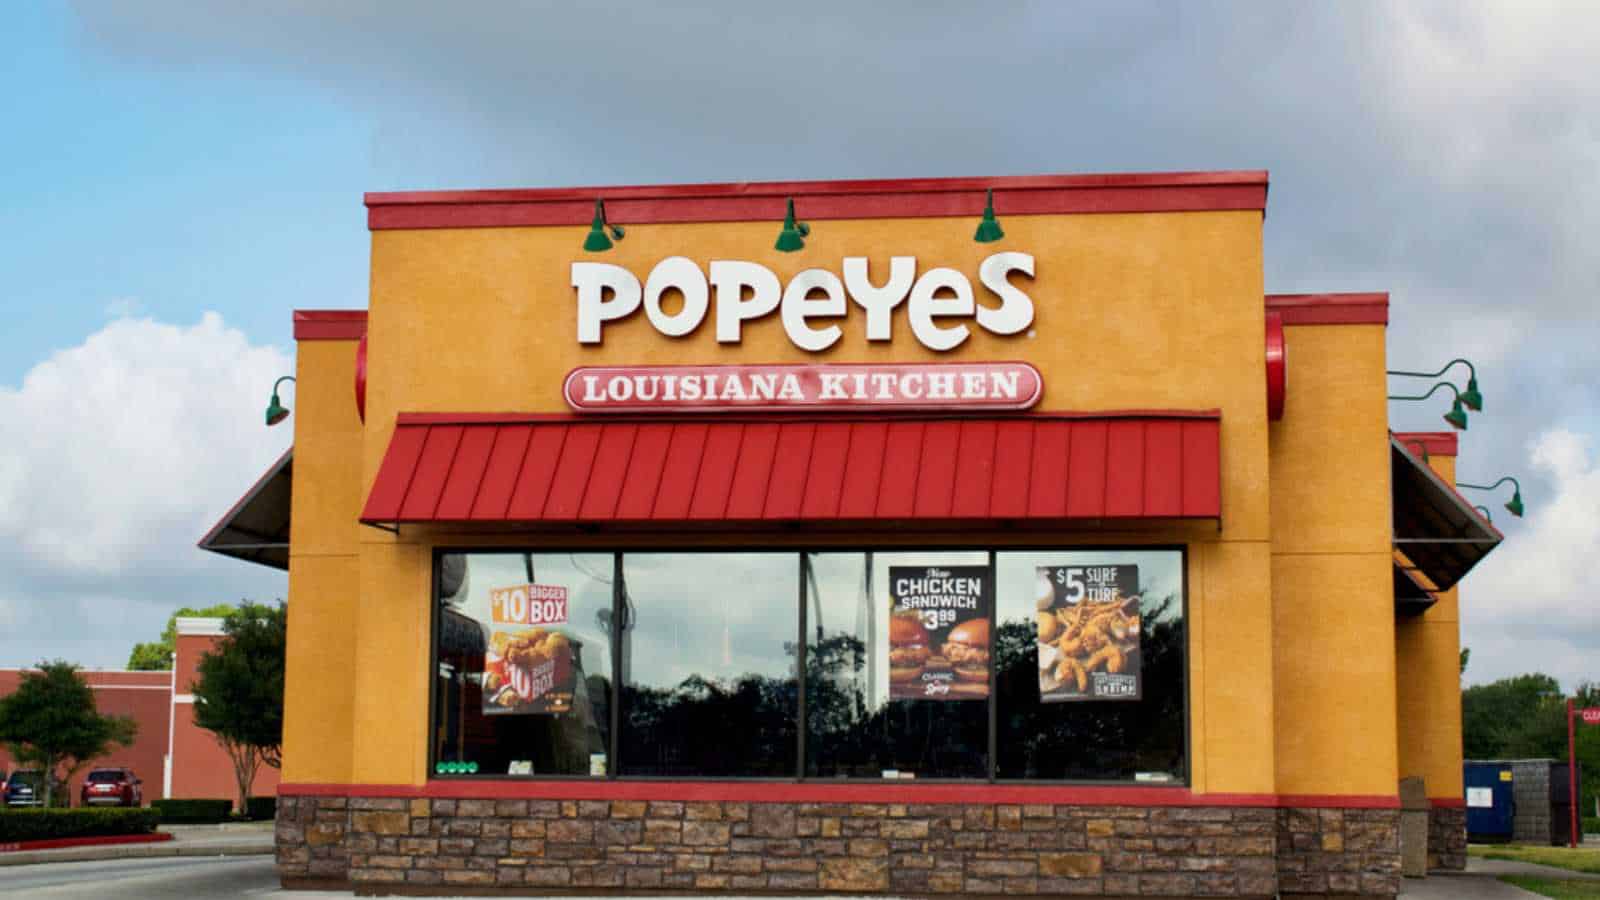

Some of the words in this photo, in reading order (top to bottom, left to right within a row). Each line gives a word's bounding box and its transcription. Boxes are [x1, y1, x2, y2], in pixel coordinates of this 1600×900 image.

[583, 374, 805, 402] LOUISIANA
[819, 371, 1021, 399] KITCHEN
[896, 578, 981, 597] CHICKEN
[1056, 568, 1085, 604] $5
[1086, 567, 1118, 583] SURF
[1087, 587, 1119, 602] TURF
[531, 600, 566, 623] BOX
[901, 595, 977, 609] SANDWICH
